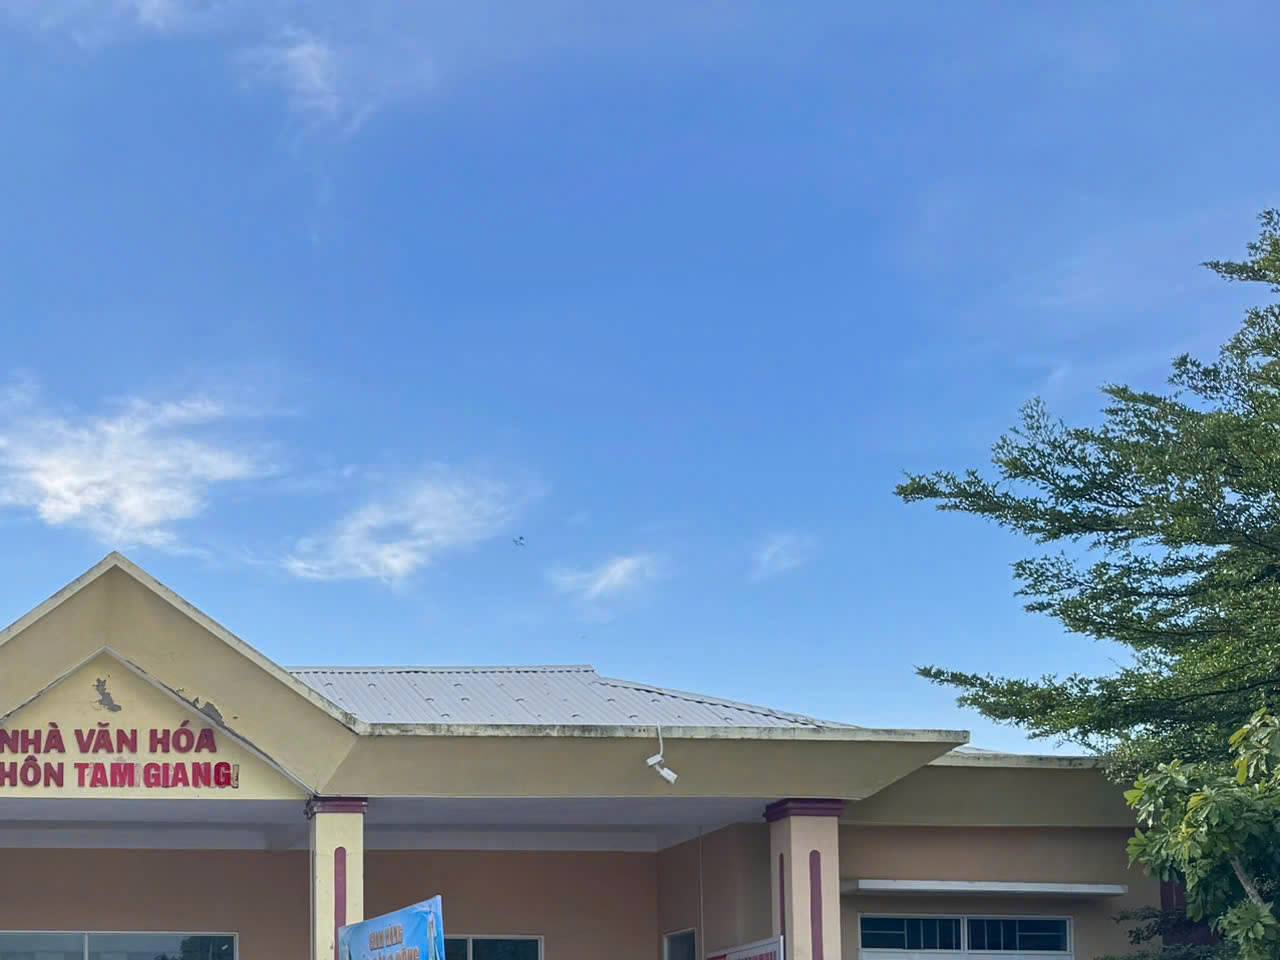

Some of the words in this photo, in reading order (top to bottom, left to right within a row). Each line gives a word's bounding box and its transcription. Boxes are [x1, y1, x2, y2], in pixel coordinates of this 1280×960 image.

[74, 721, 138, 754] VĂN
[148, 720, 218, 754] HÓA
[73, 762, 135, 788] TAM
[143, 761, 232, 789] GIANG
